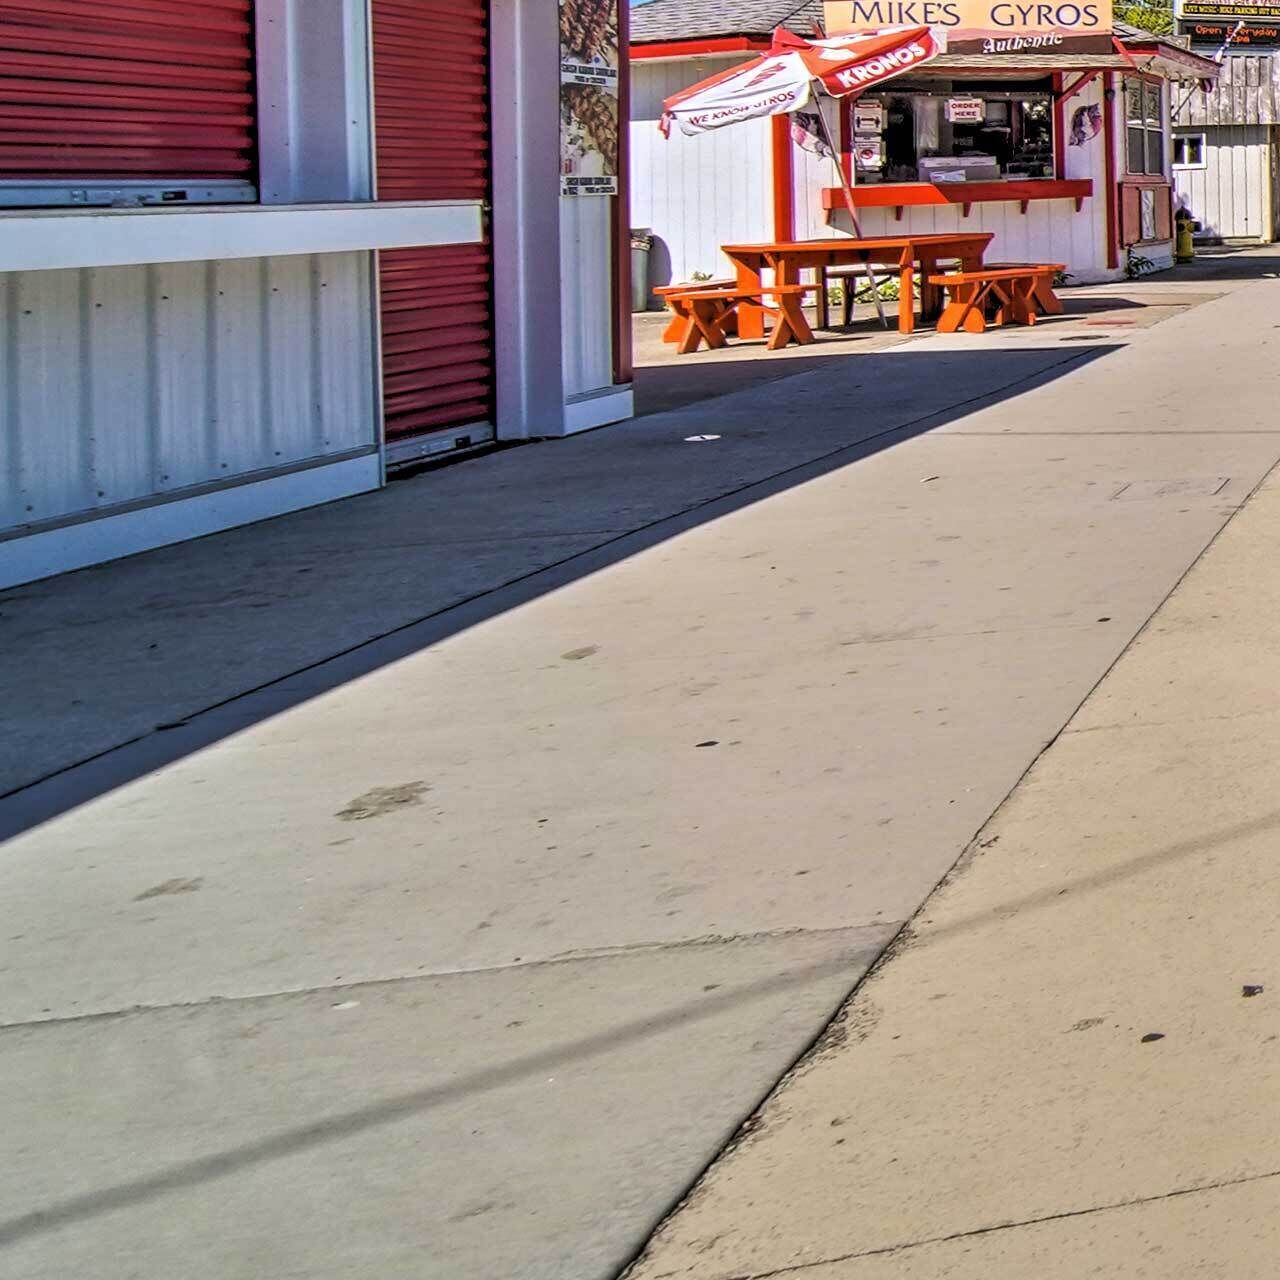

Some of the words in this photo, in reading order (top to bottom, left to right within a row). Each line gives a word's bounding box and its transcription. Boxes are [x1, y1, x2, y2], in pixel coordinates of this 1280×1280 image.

[851, 1, 961, 26] MIKE'S
[990, 3, 1100, 26] GYROS
[1195, 25, 1222, 36] Open
[1227, 25, 1277, 38] Eeryday
[983, 32, 1063, 54] Authentic
[835, 41, 926, 89] KRONOS
[688, 113, 709, 126] WE
